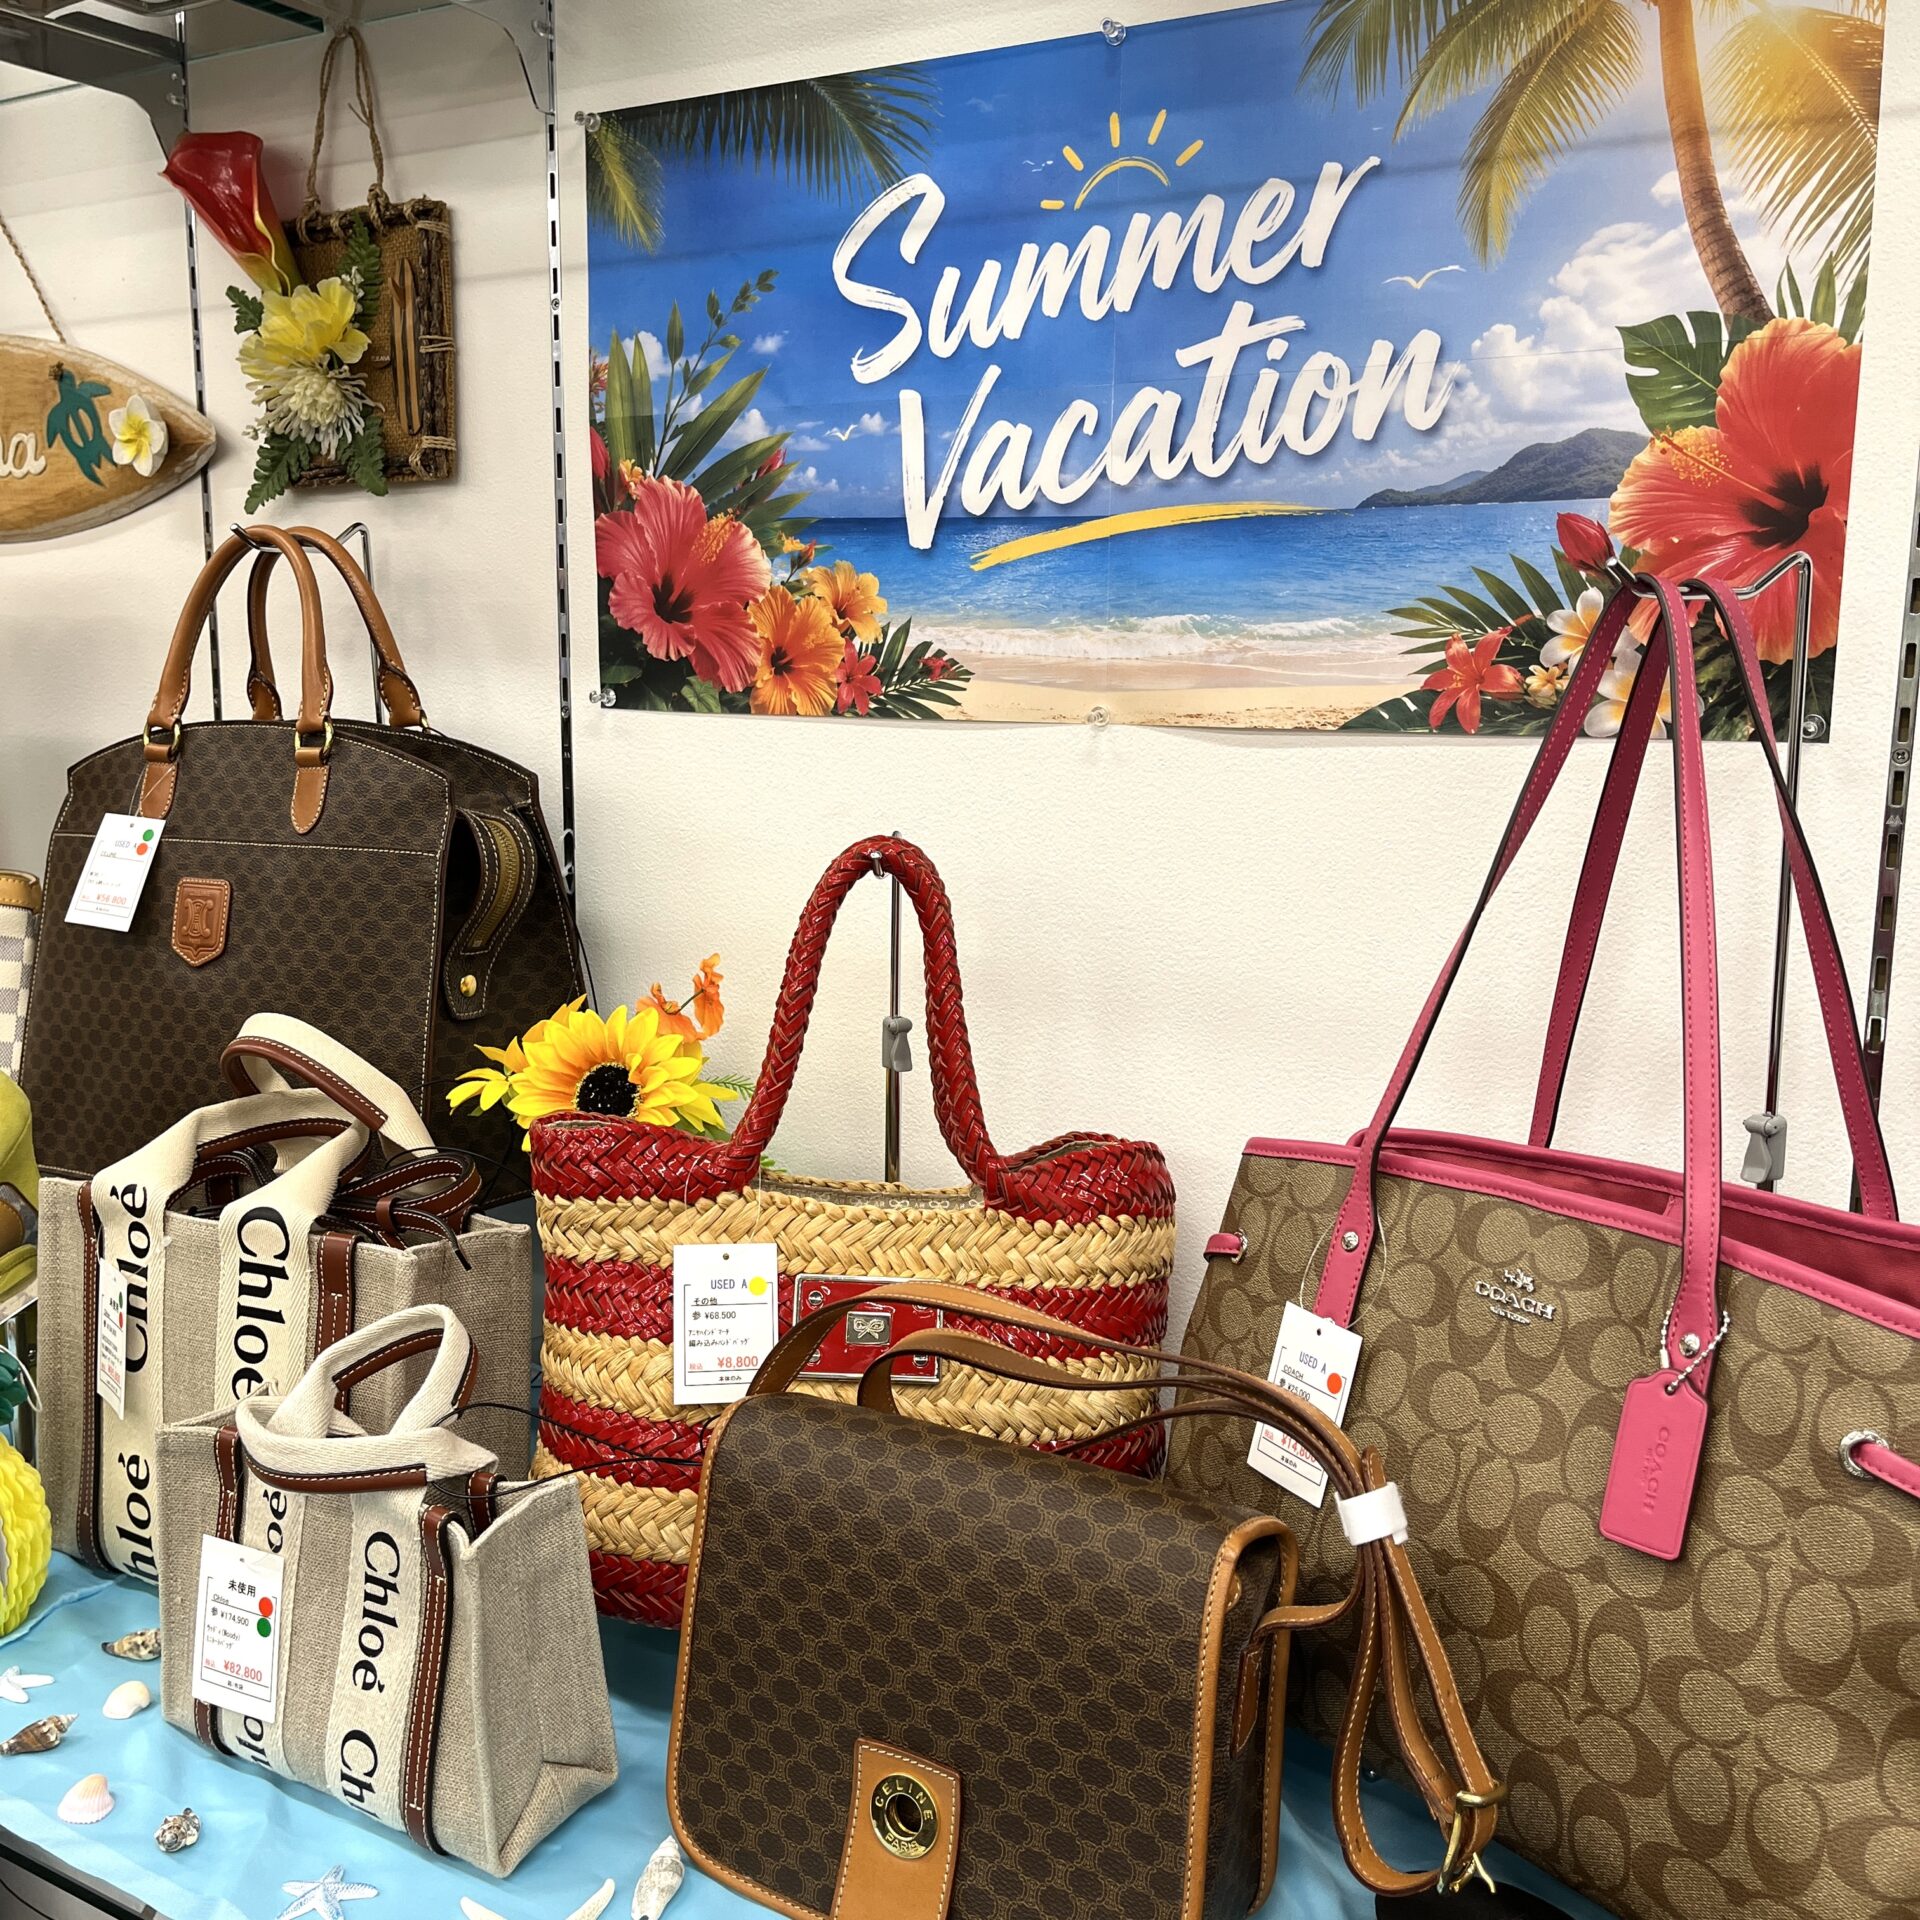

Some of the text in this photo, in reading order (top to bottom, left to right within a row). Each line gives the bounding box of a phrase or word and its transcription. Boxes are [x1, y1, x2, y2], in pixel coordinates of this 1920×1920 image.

[832, 155, 1381, 384] Summer
[898, 300, 1461, 550] Vacation
[115, 840, 131, 849] USED
[710, 1279, 748, 1290] USED A
[693, 1297, 718, 1306] その他
[1475, 1280, 1555, 1320] COACH
[717, 1356, 758, 1369] ¥8,800
[1283, 1364, 1304, 1380] COACH
[1299, 1351, 1327, 1375] USED A
[1643, 1426, 1670, 1512] COACH
[116, 1453, 159, 1583] hloé
[228, 1579, 257, 1598] 未使用
[352, 1531, 401, 1694] Chloé
[223, 1659, 263, 1682] ¥82,800
[874, 1779, 934, 1821] CELINE
[885, 1832, 921, 1853] PARIS
